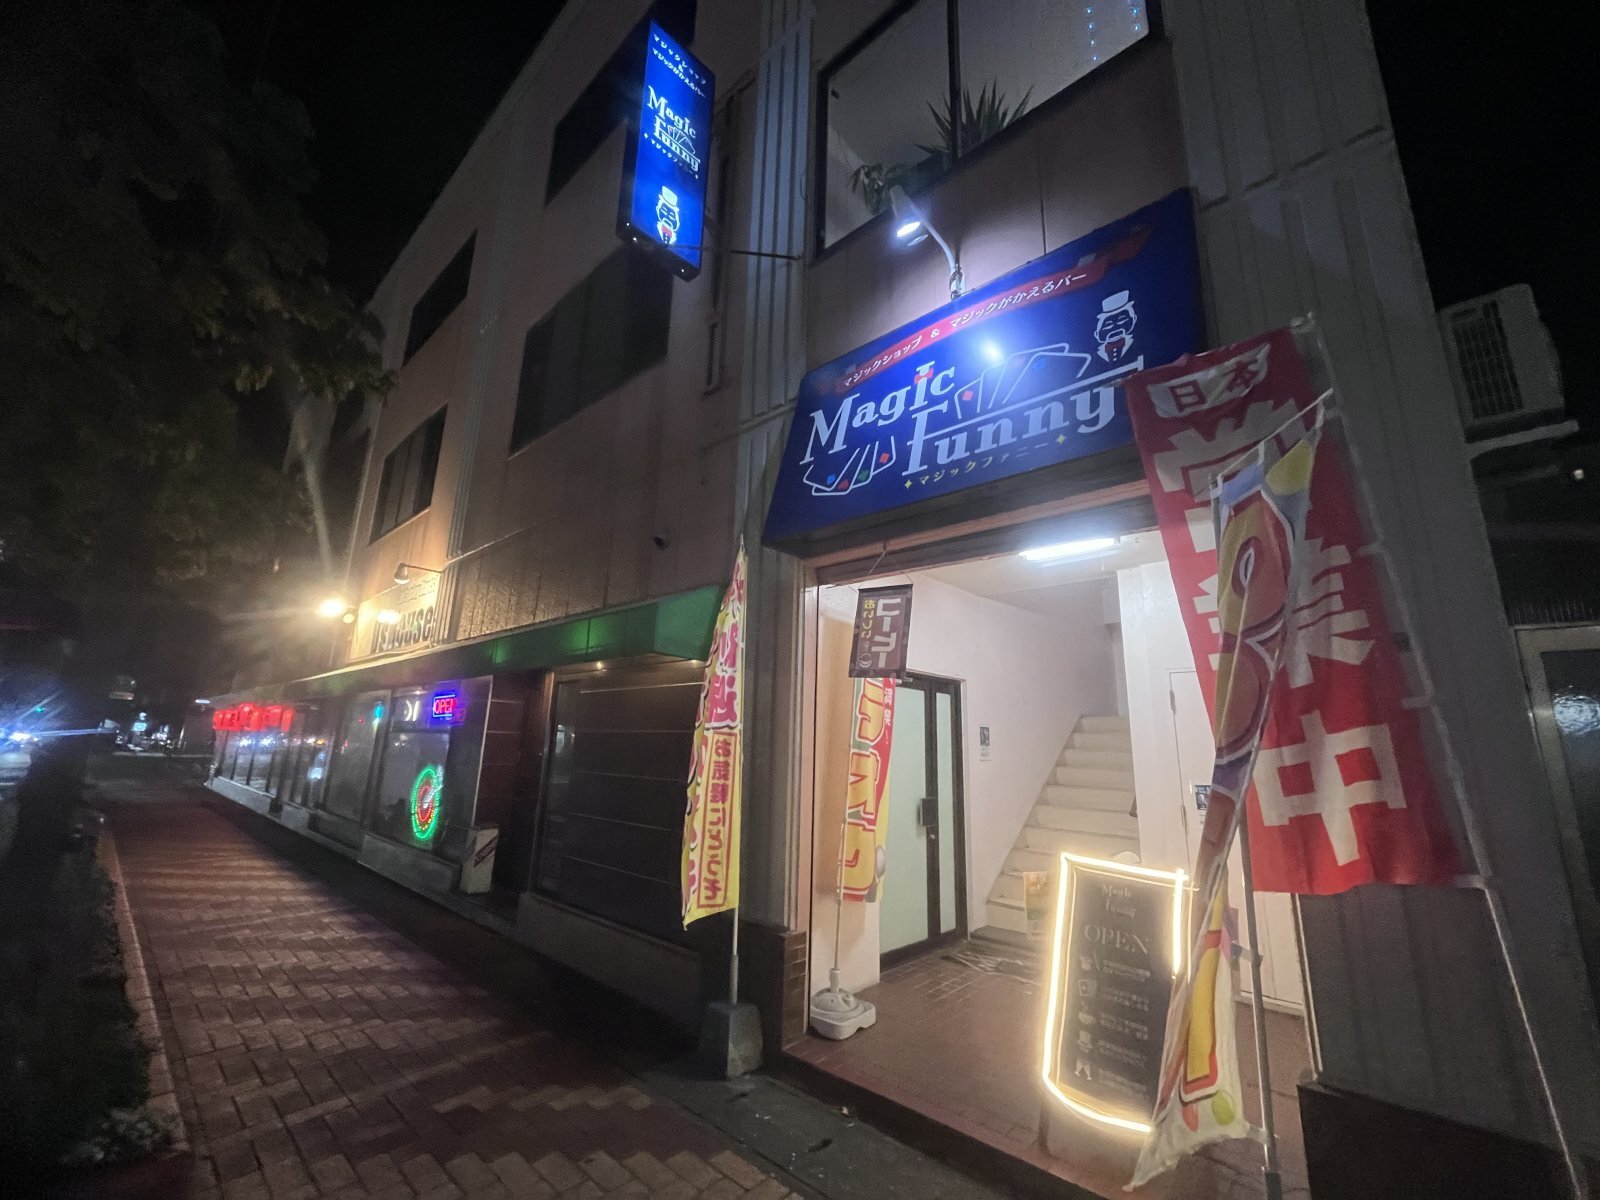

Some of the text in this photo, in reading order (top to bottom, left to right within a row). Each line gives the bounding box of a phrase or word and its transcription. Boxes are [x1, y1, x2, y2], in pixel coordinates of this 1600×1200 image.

[653, 114, 701, 172] Funny
[843, 272, 1087, 387] マジックショップ & マジックがかえるバー
[901, 357, 1144, 477] Funny
[919, 442, 1049, 486] マジックファニー
